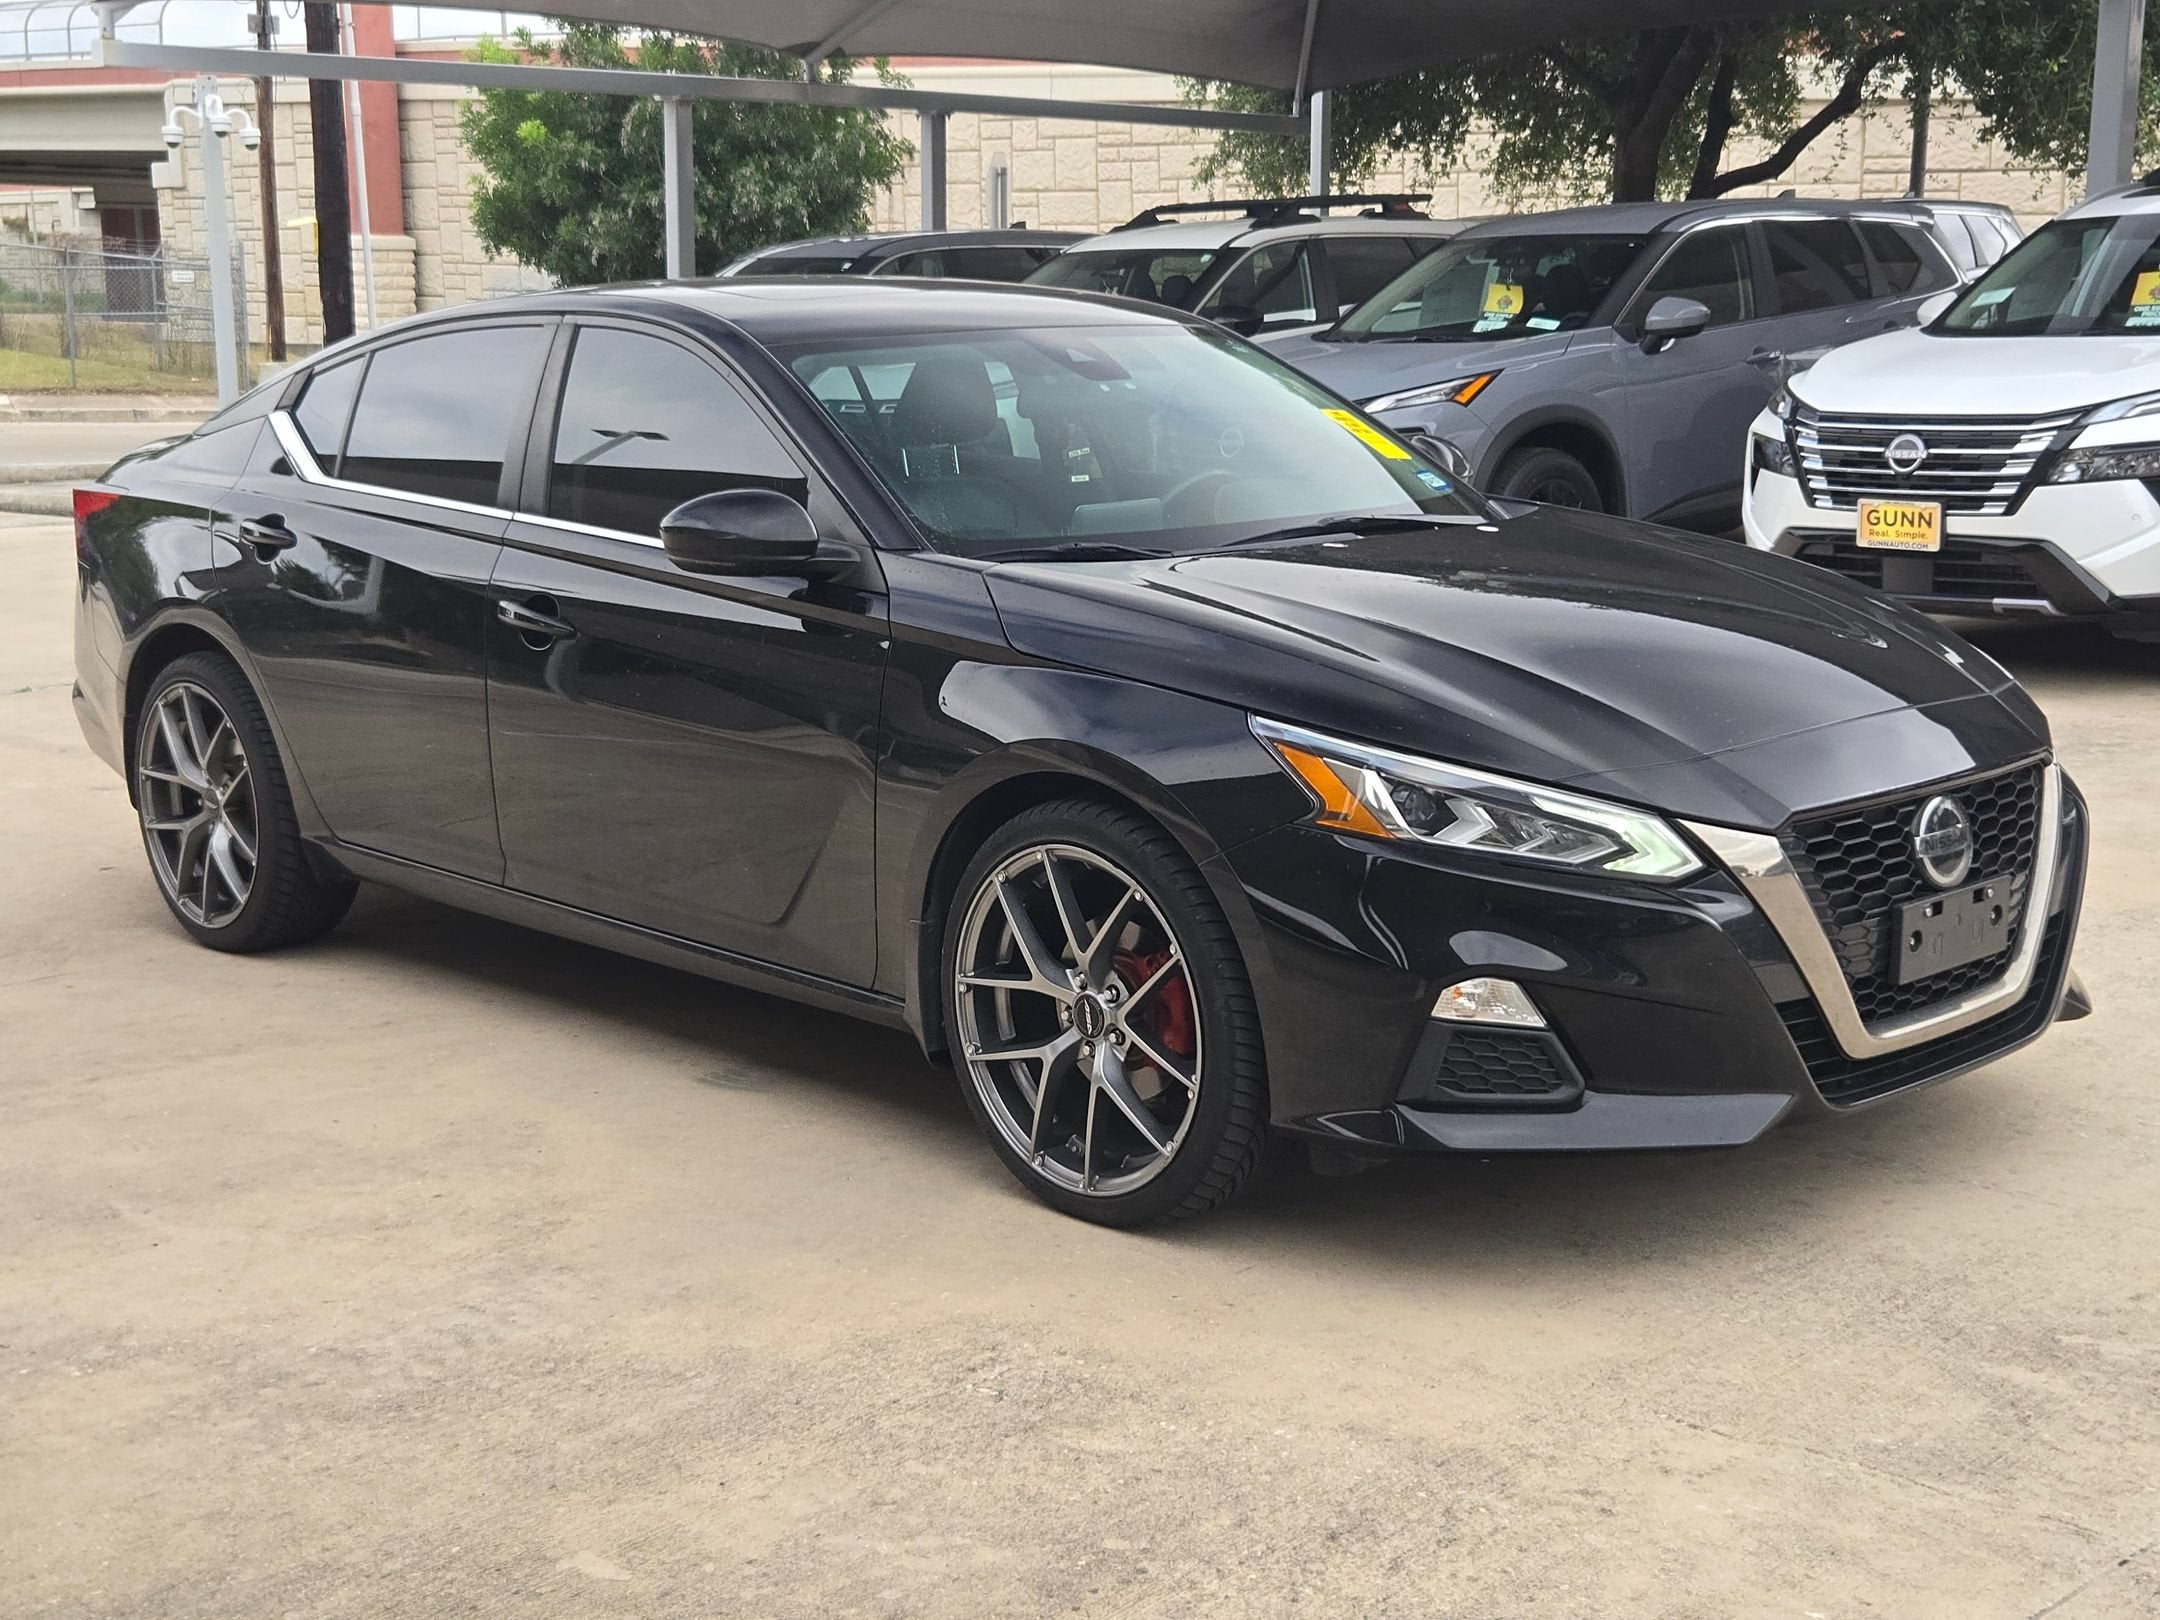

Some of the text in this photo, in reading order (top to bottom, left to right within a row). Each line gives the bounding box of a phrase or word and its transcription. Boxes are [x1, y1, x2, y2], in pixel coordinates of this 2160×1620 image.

[1885, 449, 1928, 459] NISSAN
[1867, 509, 1933, 529] GUNN
[1869, 529, 1928, 540] Real. Simple.
[1867, 540, 1929, 550] GUNNAUTO.COM
